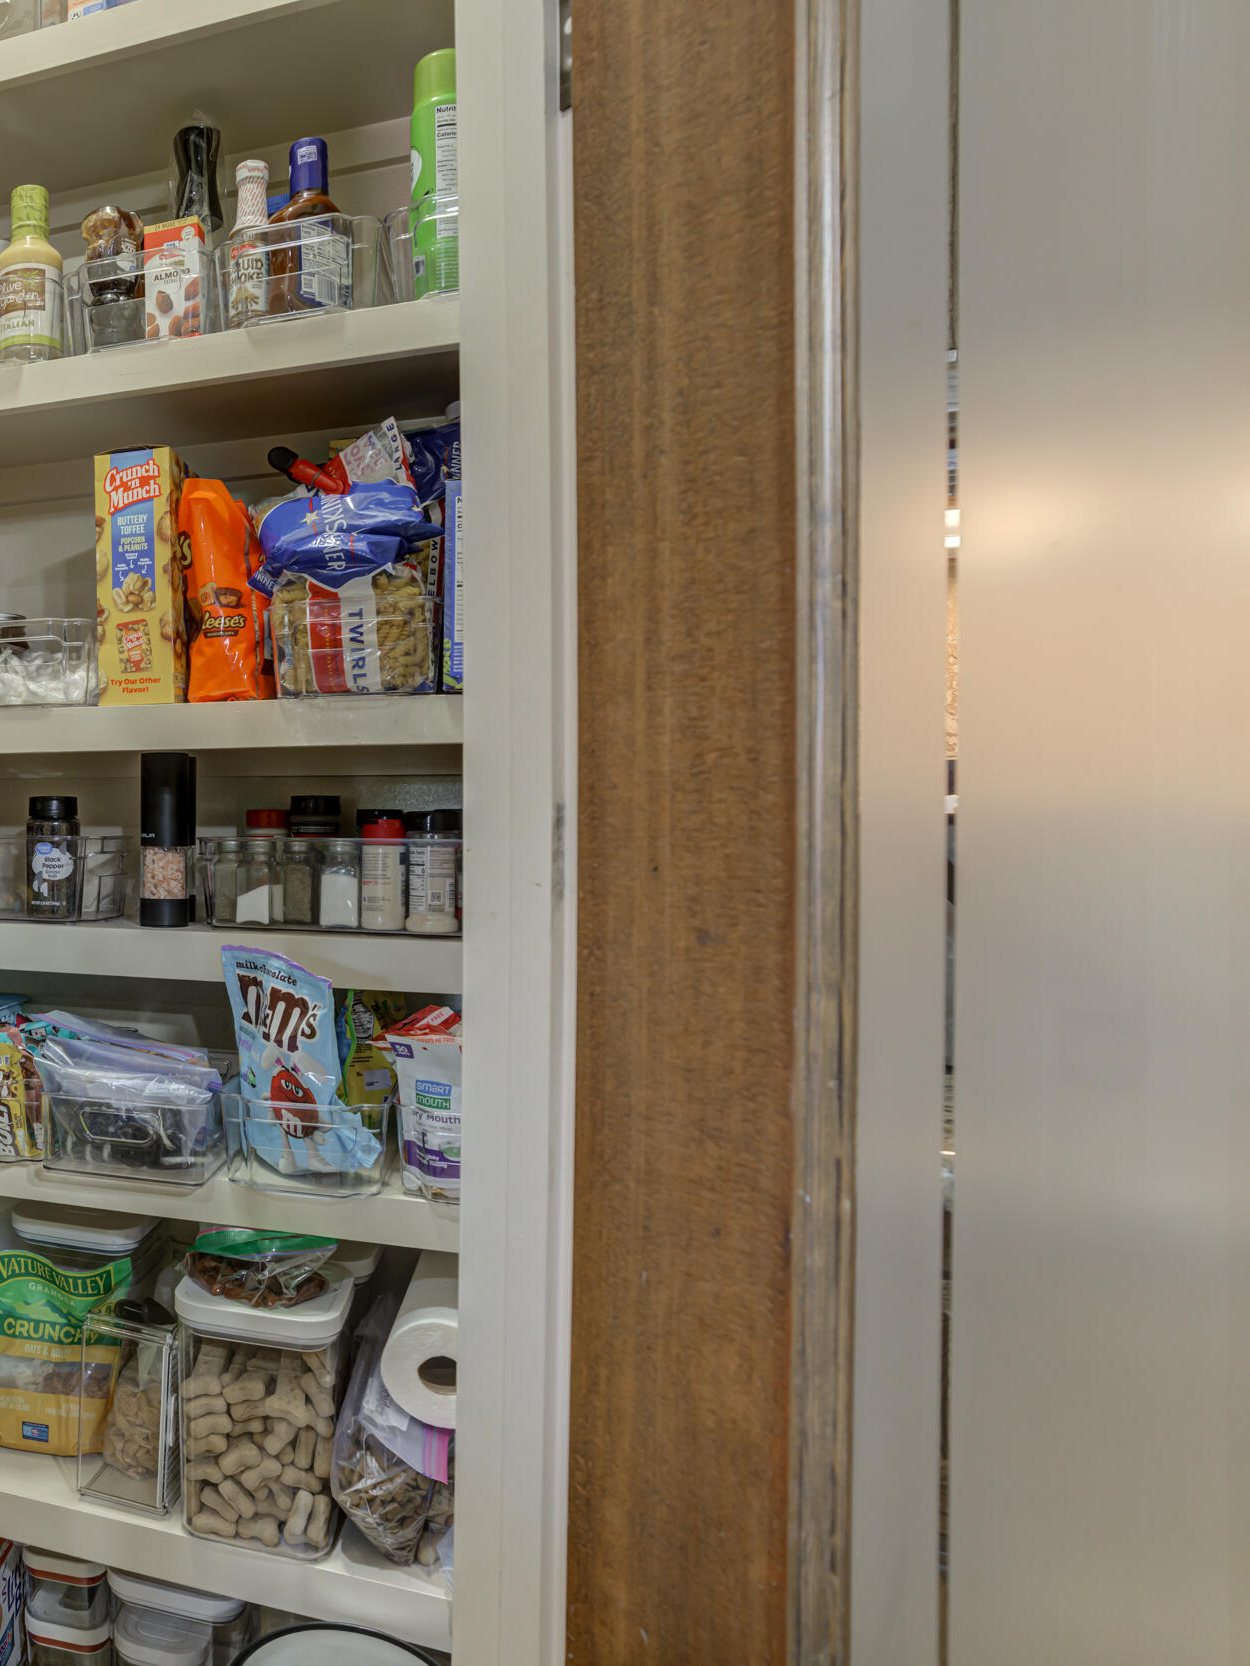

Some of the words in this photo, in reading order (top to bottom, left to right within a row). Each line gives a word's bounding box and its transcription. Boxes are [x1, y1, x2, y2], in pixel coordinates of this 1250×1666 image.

[104, 459, 159, 493] Crunch
[109, 480, 160, 514] Munch
[117, 513, 148, 526] BUTTERY
[119, 524, 146, 535] TOFFEE
[120, 536, 146, 545] POPCORN
[124, 542, 148, 552] PEANUTS
[428, 538, 439, 596] ELBOW
[347, 607, 370, 693] TWIRLS
[110, 679, 122, 688] Try
[122, 678, 137, 686] Our
[138, 677, 161, 686] Other
[236, 960, 258, 972] milk
[258, 964, 298, 987] chocolate
[27, 1281, 77, 1308] GRANOLA
[53, 1273, 108, 1297] VALLEY
[3, 1316, 100, 1345] CRUNCHY
